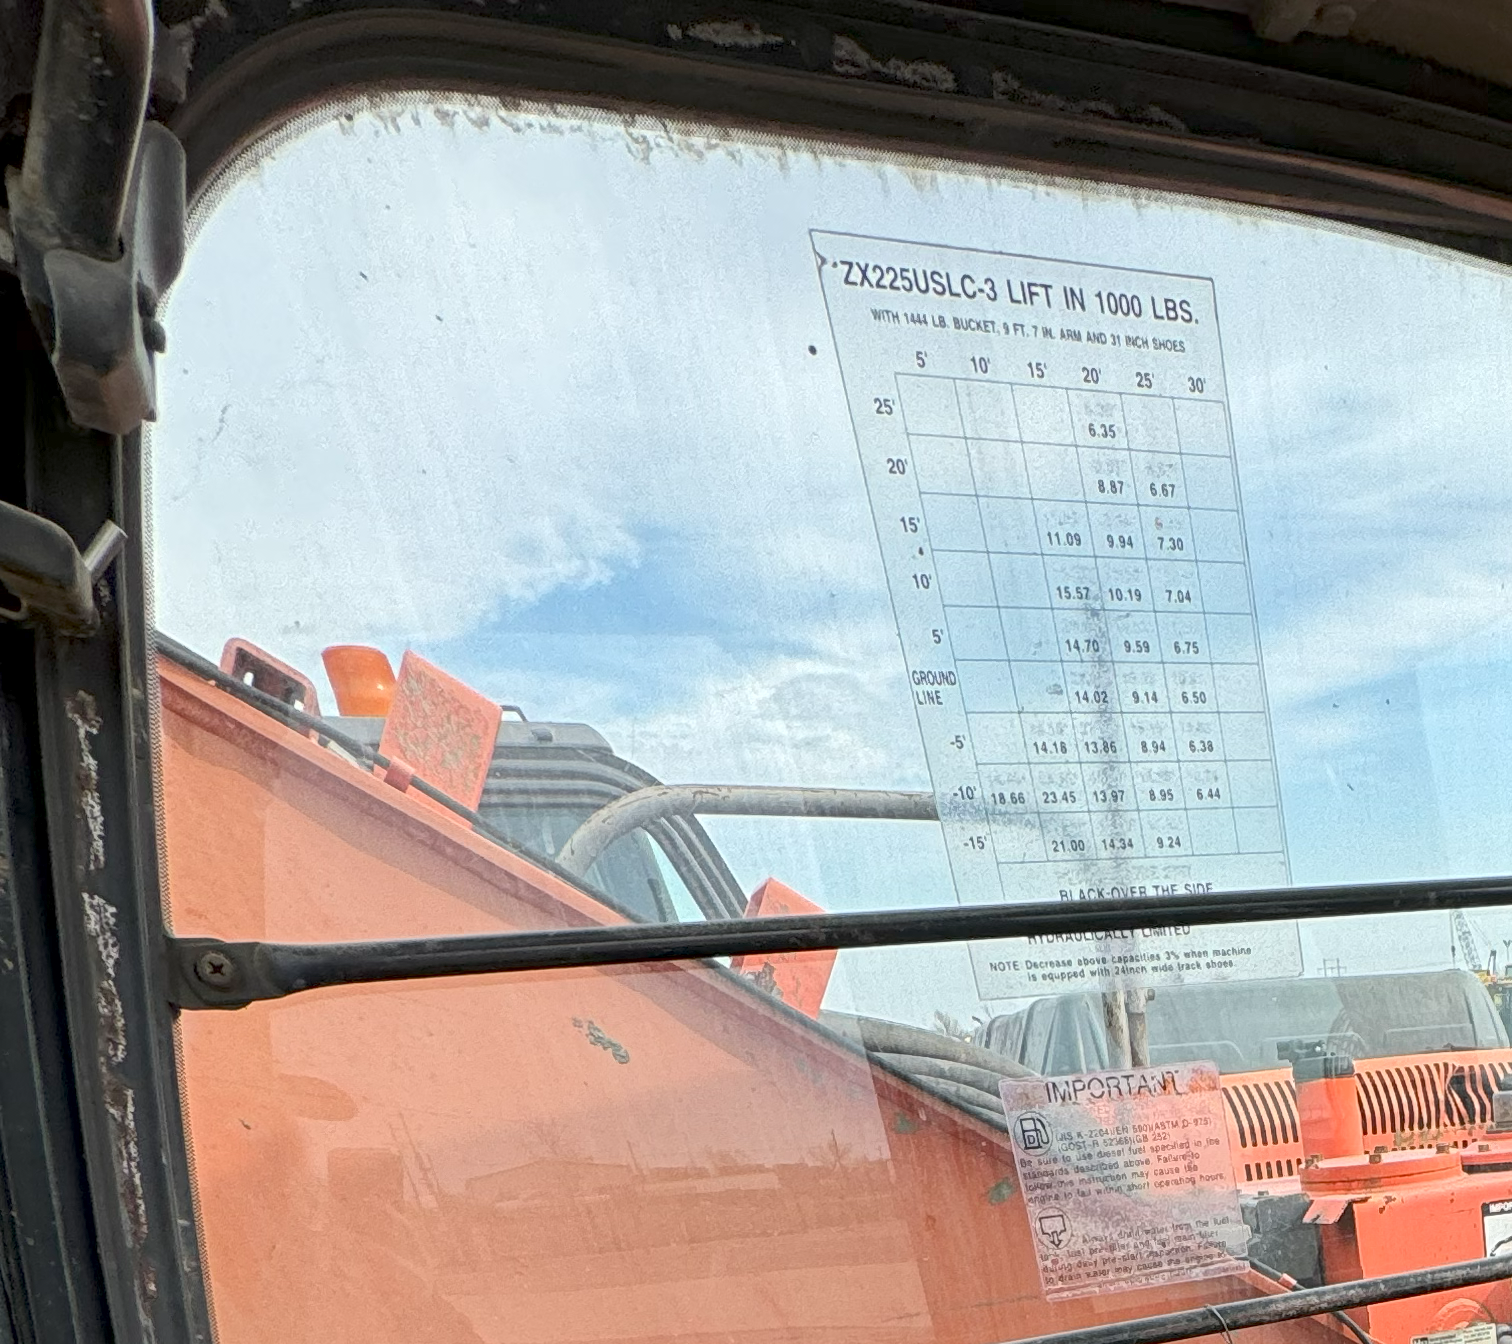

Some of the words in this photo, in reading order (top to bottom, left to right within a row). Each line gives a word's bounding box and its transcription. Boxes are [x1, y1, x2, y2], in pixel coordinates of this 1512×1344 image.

[840, 260, 998, 302] ZX225USLC-3
[1007, 279, 1053, 308] LIFT
[1063, 286, 1086, 312] IN
[1095, 291, 1143, 318] 1000
[1151, 296, 1199, 324] LBS.
[870, 308, 900, 324] WITH
[1060, 328, 1082, 342] ARM
[1087, 331, 1107, 345] AND
[1111, 334, 1121, 347] 31
[1125, 335, 1149, 349] INCH
[1152, 337, 1185, 353] SHOES
[1088, 423, 1116, 438] 6.35
[1097, 479, 1124, 496] 8.87
[1149, 482, 1175, 499] 6.67
[1047, 531, 1082, 547] 11.09
[1106, 534, 1134, 550] 9.94
[1157, 536, 1184, 552] 7.30
[1056, 585, 1090, 601] 15.57
[1108, 587, 1142, 602] 10.19
[1165, 588, 1192, 604] 7.04
[1065, 638, 1100, 654] 14.70
[1123, 639, 1151, 654] 9.59
[1173, 640, 1200, 656] 6.75
[912, 669, 957, 687] GROUND
[915, 690, 943, 706] LINE
[1132, 690, 1159, 705] 9.14
[1181, 690, 1207, 705] 6.50
[1042, 791, 1076, 803] 23.45
[1093, 790, 1124, 803] 13.97
[1149, 788, 1174, 801] 8.95
[1196, 788, 1221, 800] 6.44
[1052, 839, 1085, 852] 21.00
[1102, 838, 1134, 850] 14.34
[1156, 836, 1181, 849] 9.24
[1184, 948, 1208, 959] when
[1213, 946, 1251, 957] machine
[1090, 966, 1110, 977] with
